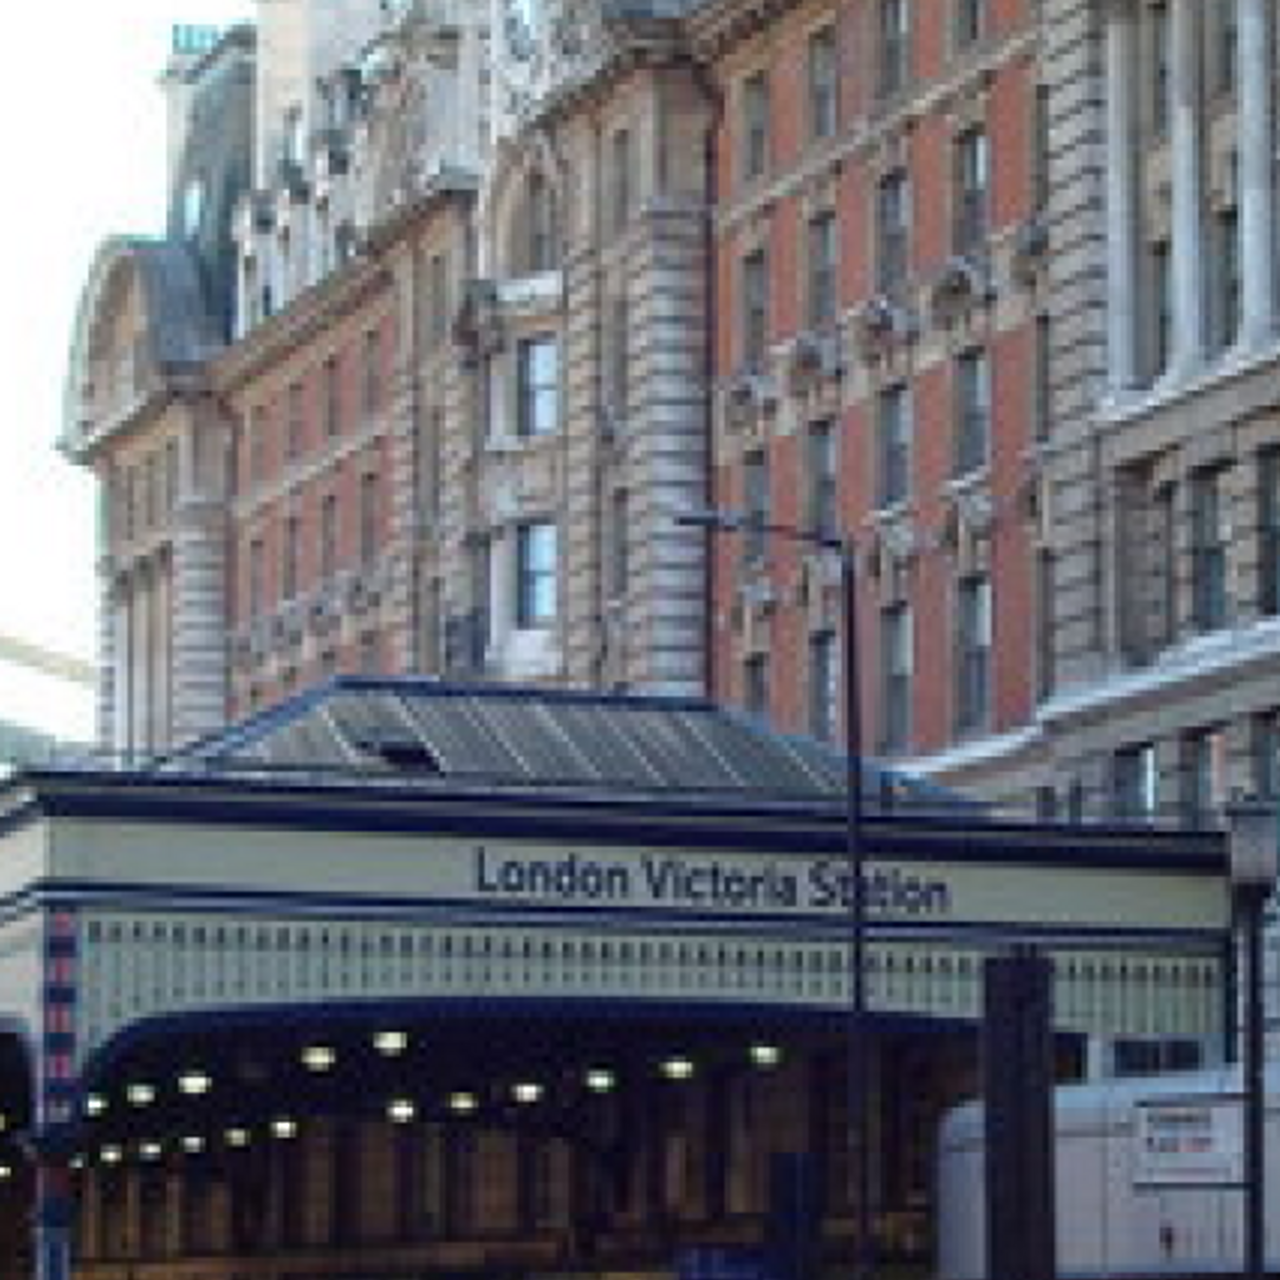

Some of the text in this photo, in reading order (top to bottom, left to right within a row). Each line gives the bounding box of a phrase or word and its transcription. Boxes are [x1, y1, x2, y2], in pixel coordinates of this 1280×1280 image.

[476, 845, 950, 915] London Victoria Station
